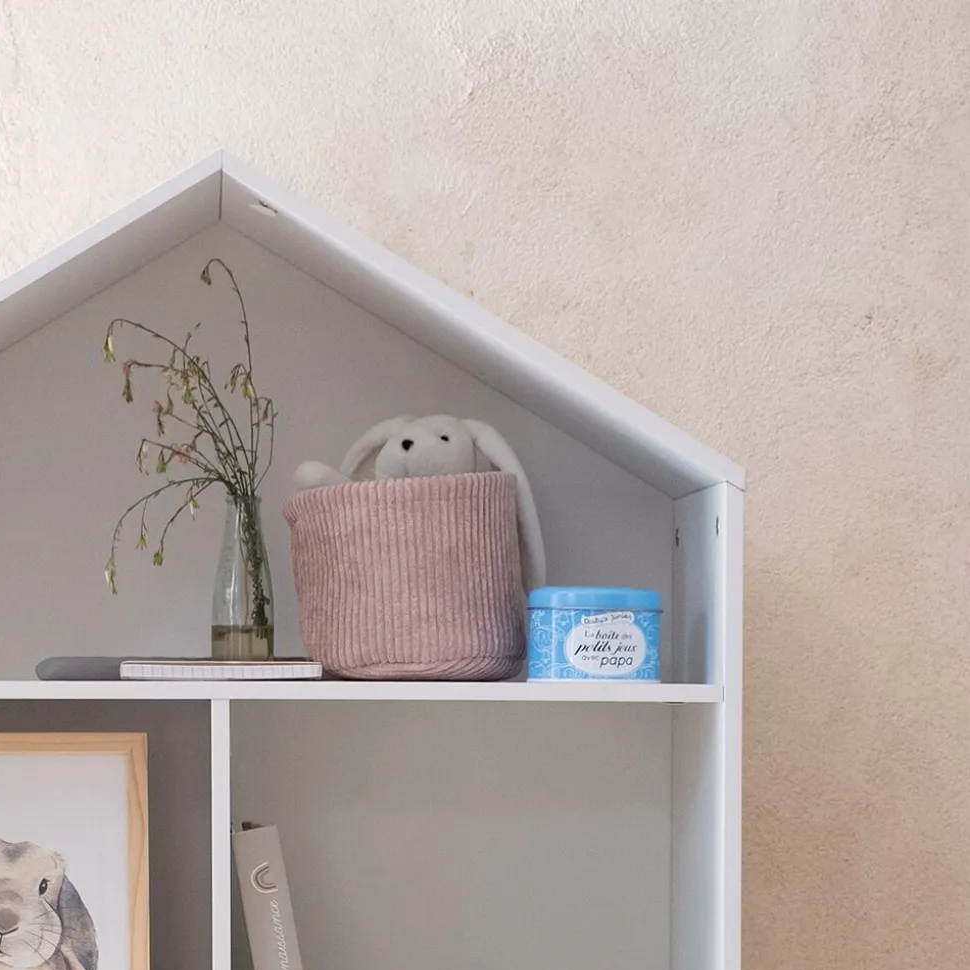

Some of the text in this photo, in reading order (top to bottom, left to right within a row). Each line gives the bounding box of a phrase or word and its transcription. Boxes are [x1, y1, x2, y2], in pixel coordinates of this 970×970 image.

[574, 641, 638, 655] petits jeux
[599, 656, 633, 668] papa
